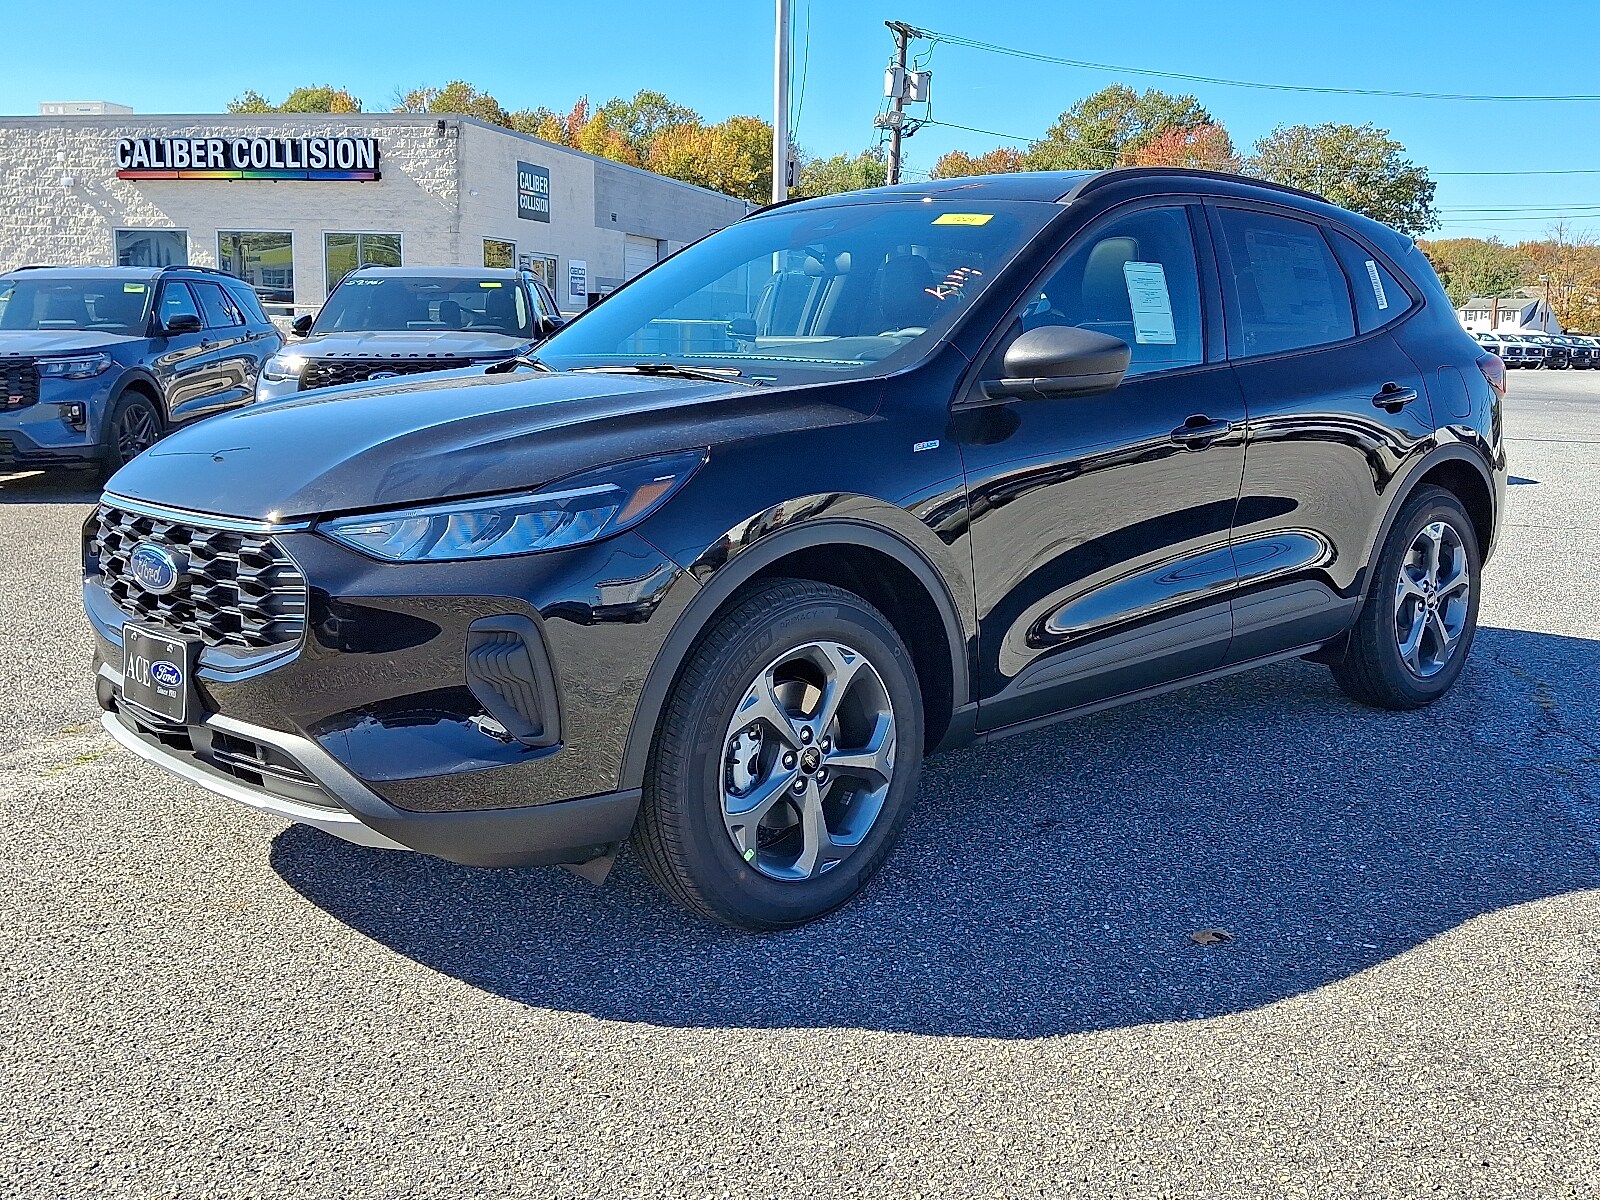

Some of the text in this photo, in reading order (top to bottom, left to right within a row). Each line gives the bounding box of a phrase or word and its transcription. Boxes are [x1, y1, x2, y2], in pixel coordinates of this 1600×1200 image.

[115, 138, 375, 168] CALIBER COLLISION
[519, 172, 548, 193] CALIBER
[520, 194, 548, 212] COLLISION
[570, 266, 586, 276] GEICO
[8, 395, 24, 404] ST
[126, 652, 179, 687] ACE Ford
